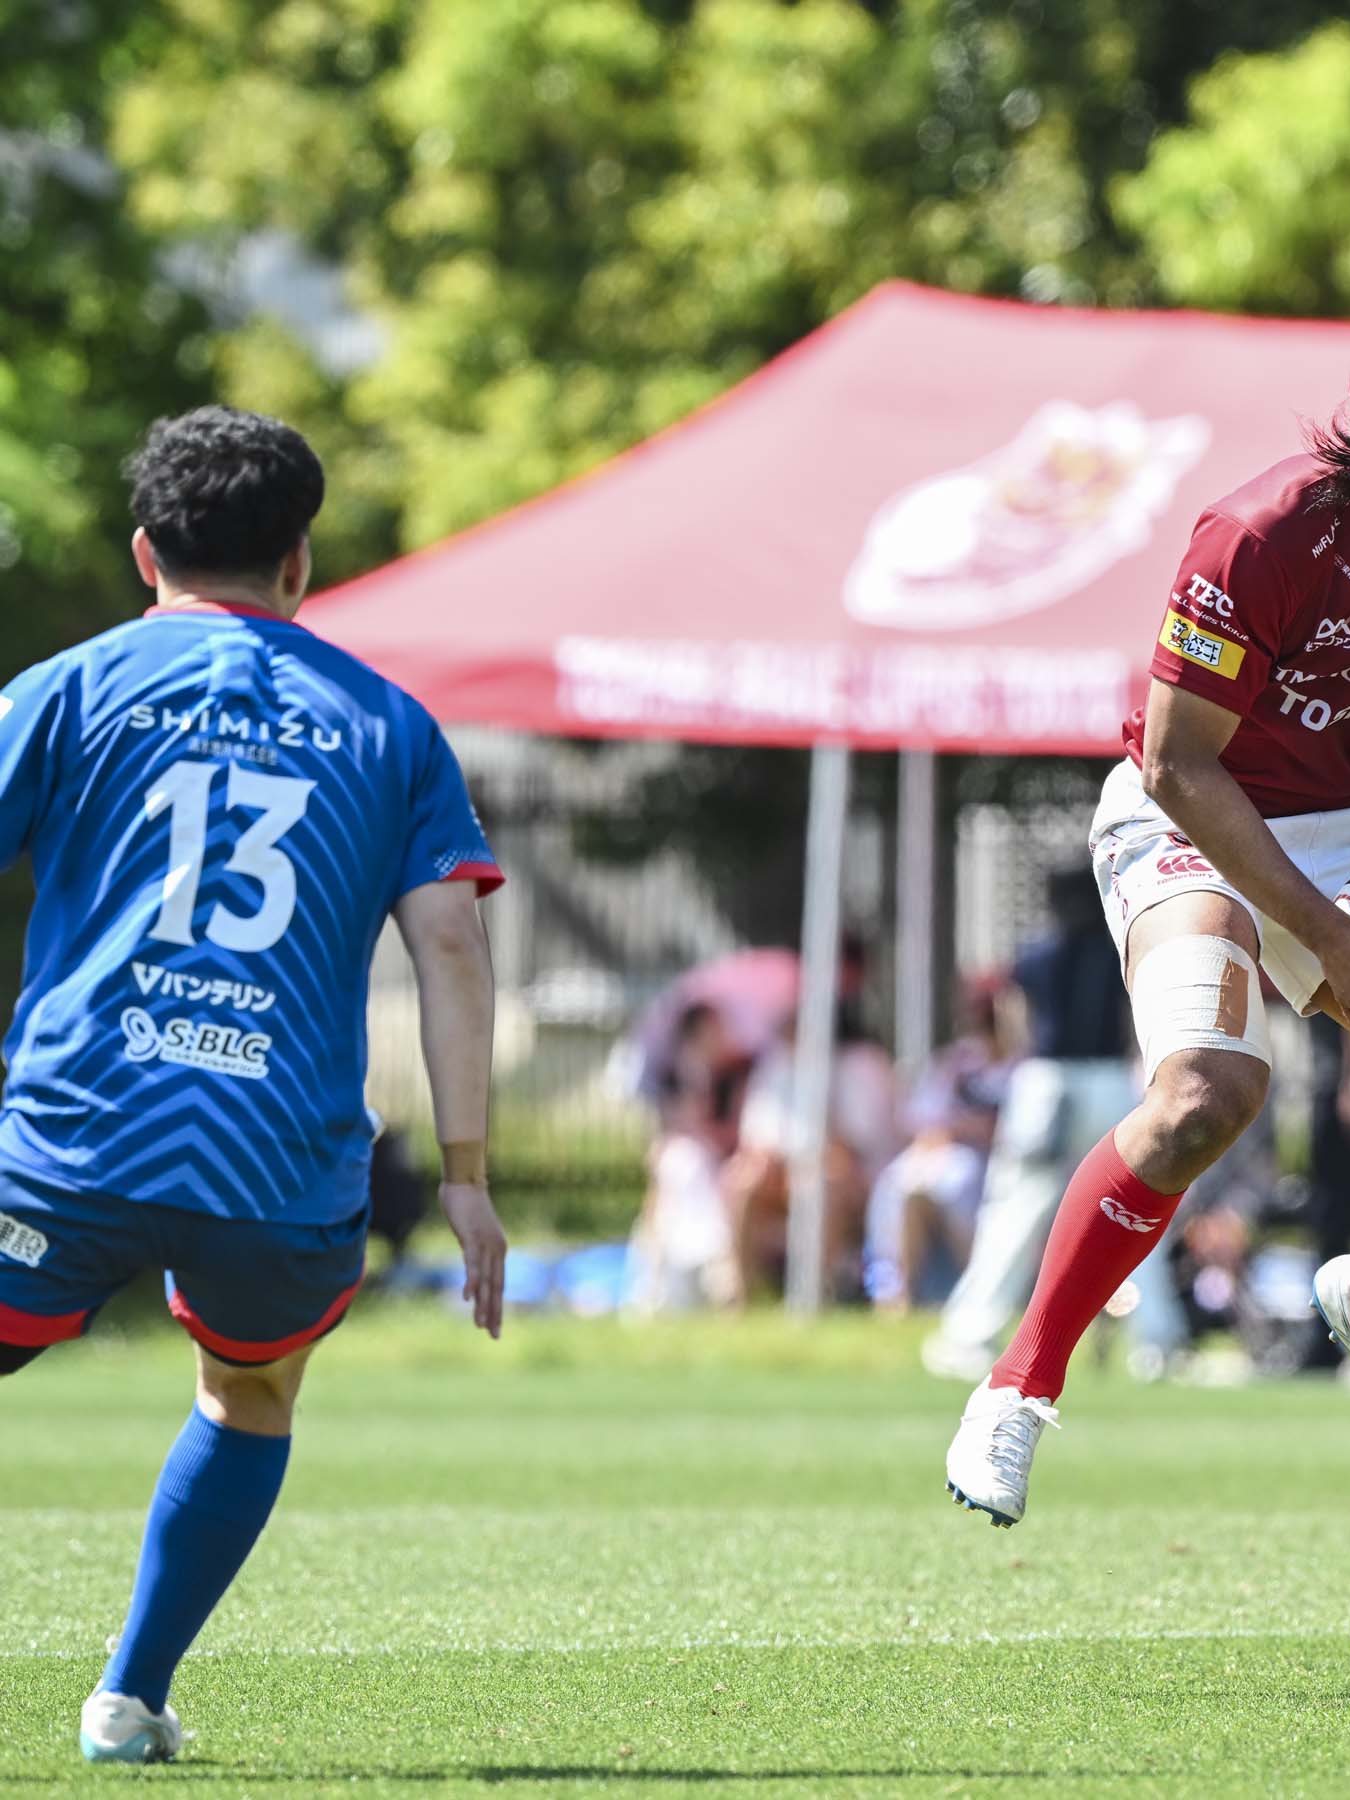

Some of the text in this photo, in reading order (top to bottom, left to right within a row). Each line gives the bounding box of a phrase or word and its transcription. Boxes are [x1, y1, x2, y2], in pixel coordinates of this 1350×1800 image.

[1187, 573, 1234, 617] TEC
[1186, 642, 1217, 662] レシート
[1191, 634, 1219, 653] スマート
[129, 704, 342, 752] SHIMIZU
[144, 757, 318, 954] 13
